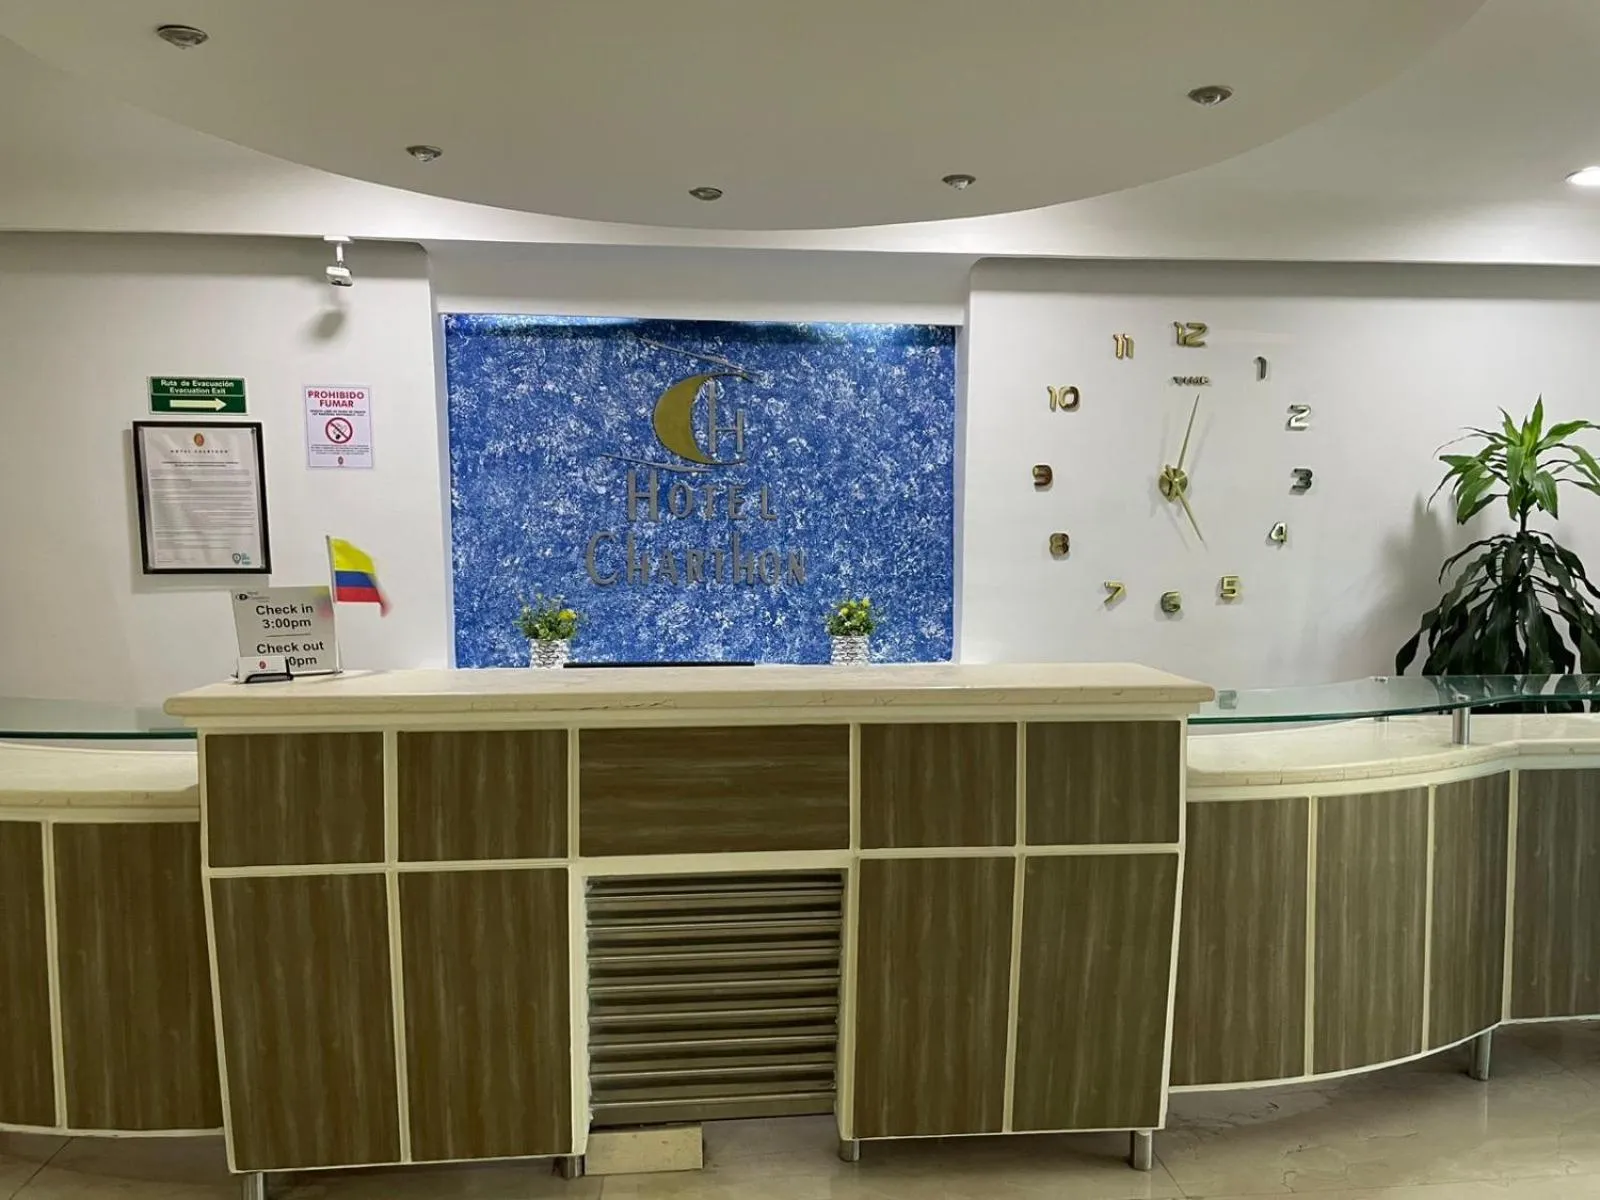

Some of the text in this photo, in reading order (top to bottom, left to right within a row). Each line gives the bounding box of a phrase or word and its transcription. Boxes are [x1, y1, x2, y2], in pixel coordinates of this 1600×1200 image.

[1113, 333, 1135, 360] 11
[1174, 321, 1208, 348] 12
[1255, 356, 1268, 380] 1
[160, 379, 235, 388] Ruta de Evacuación
[169, 387, 227, 395] Evacuation Exit
[307, 390, 365, 400] PROHIBIDO
[320, 399, 354, 408] FUMAR
[1047, 385, 1080, 413] 10
[1287, 404, 1312, 430] 2
[1032, 464, 1053, 488] 9
[1291, 468, 1313, 492] 3
[1049, 532, 1071, 556] 8
[1269, 521, 1288, 545] 4
[1103, 580, 1126, 604] 7
[1219, 576, 1240, 601] 5
[255, 603, 314, 615] Check in
[1160, 591, 1182, 613] 6
[262, 618, 312, 630] 3:00pm
[256, 641, 325, 654] Check out
